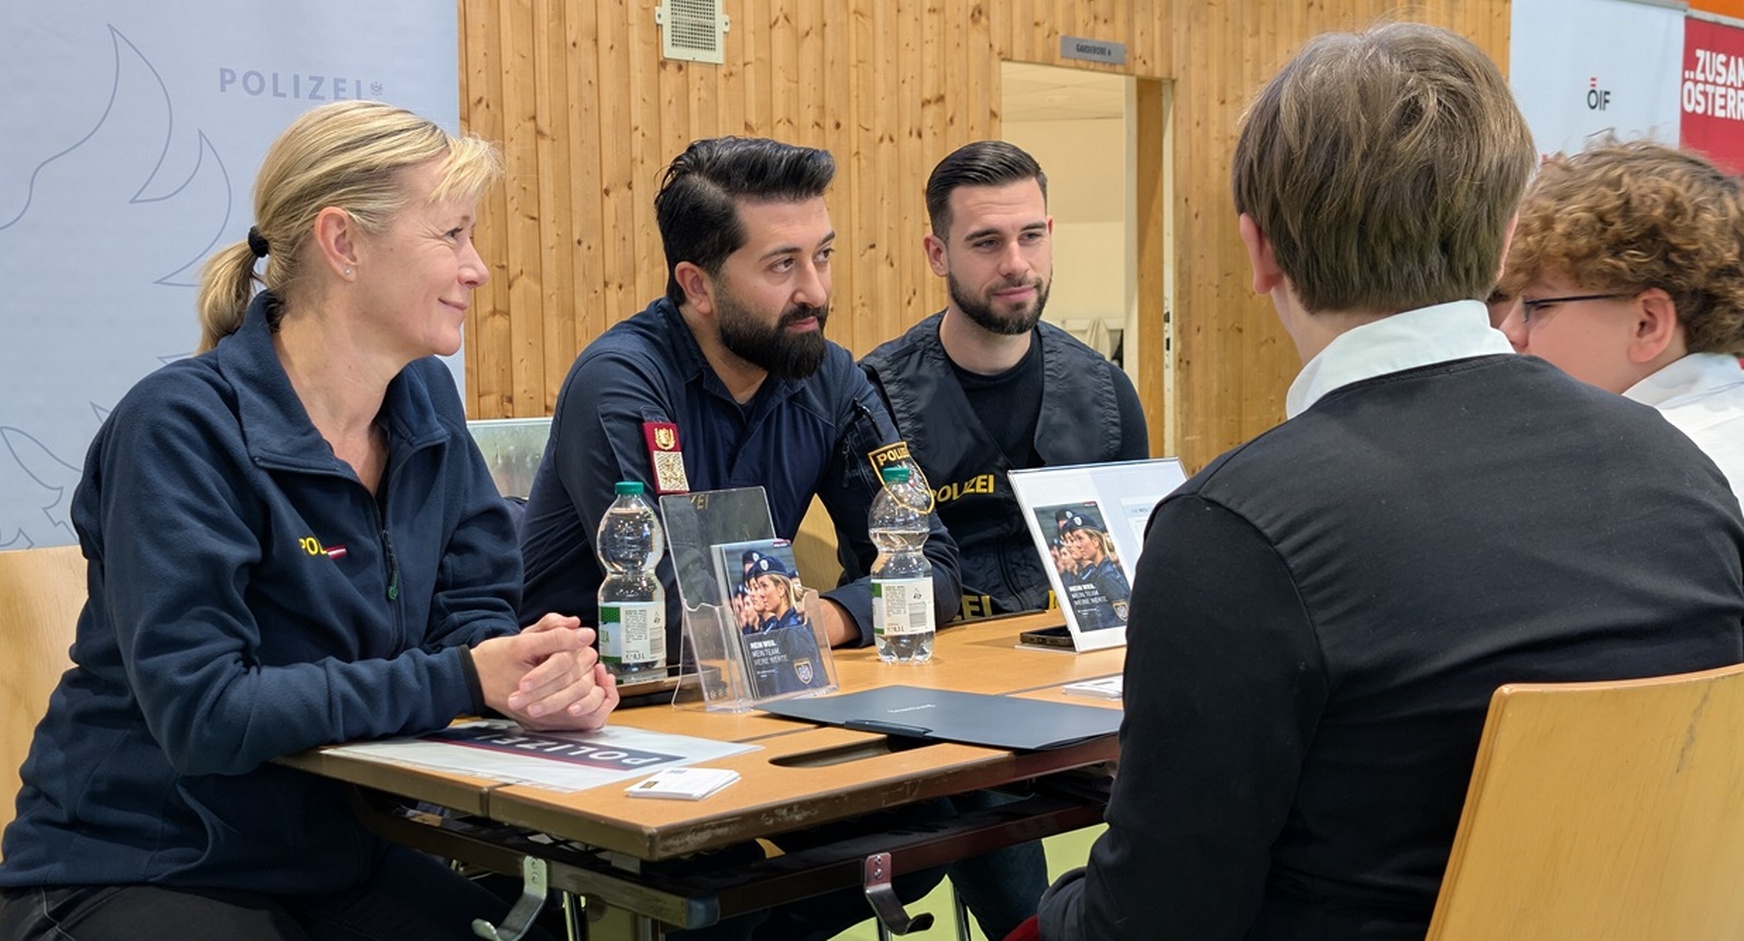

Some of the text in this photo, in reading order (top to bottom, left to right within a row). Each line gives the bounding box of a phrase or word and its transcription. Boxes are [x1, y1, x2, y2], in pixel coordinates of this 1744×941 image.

[1075, 43, 1107, 57] GARDEROBE
[219, 67, 362, 100] POLIZEI
[1587, 77, 1611, 111] ÖIF
[475, 734, 662, 766] POLIZEI
